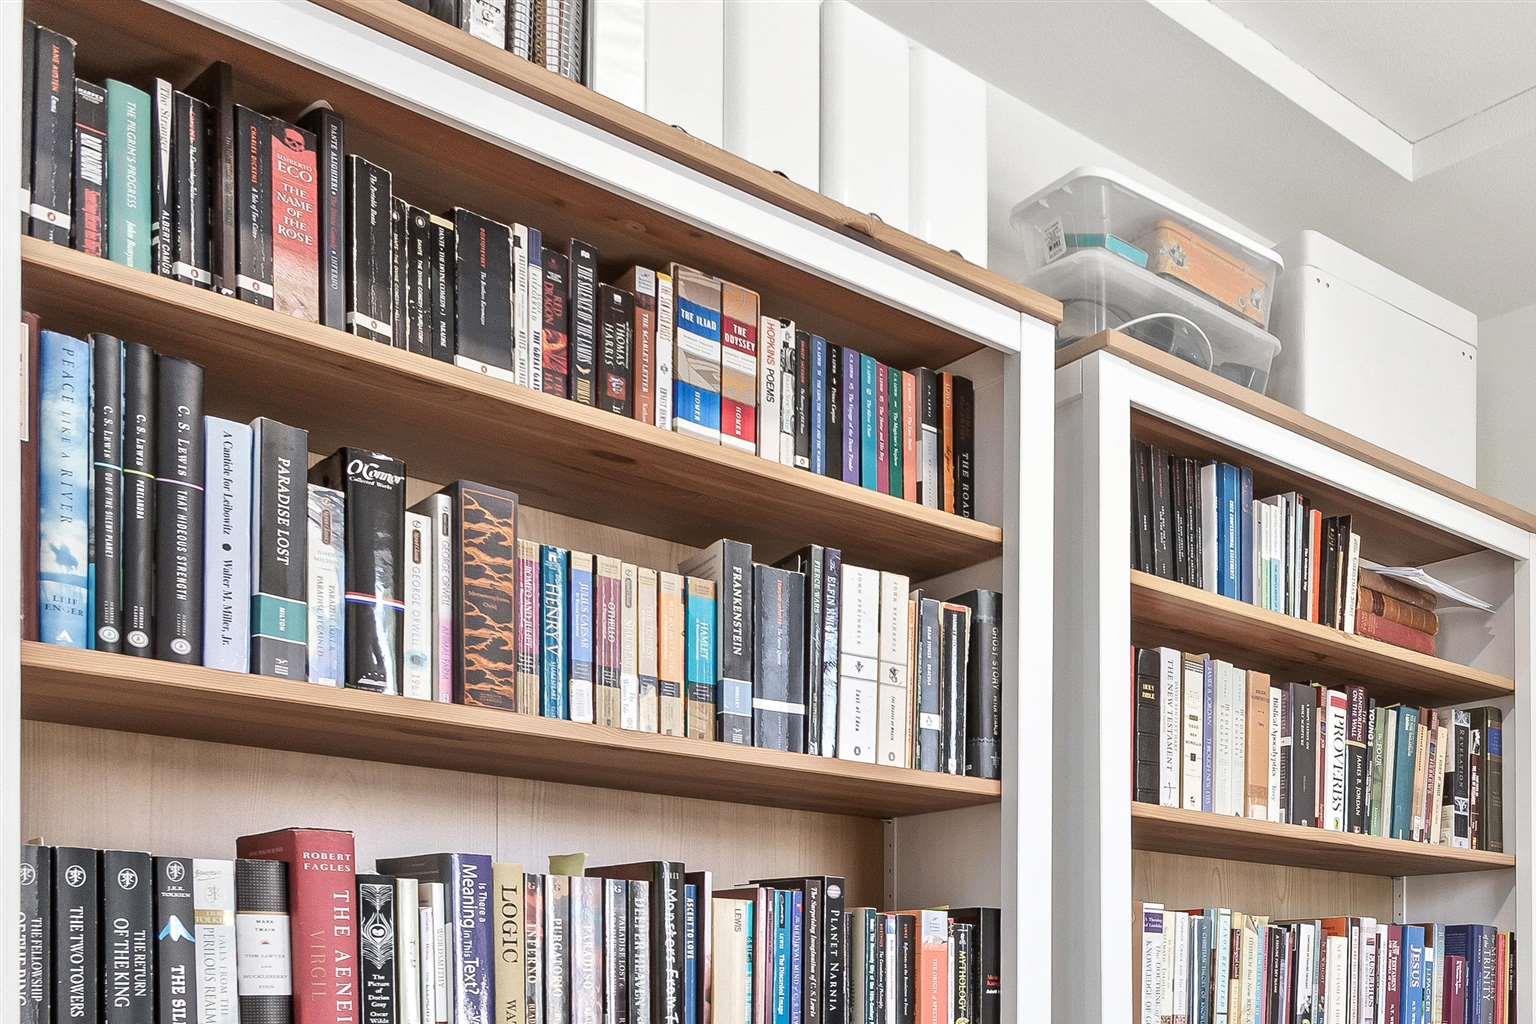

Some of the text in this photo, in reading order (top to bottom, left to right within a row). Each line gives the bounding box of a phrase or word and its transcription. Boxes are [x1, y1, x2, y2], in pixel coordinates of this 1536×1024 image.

[127, 102, 136, 208] THE PILGRIM'S PROGRESS
[330, 125, 338, 149] DANTE
[330, 151, 339, 190] ALIGHIERI
[604, 323, 614, 366] HARRIS
[615, 322, 625, 366] THOMAS
[765, 322, 777, 402] HOPKINS POEMS
[177, 405, 190, 476] C. S. LEWIS
[223, 441, 234, 476] Canticle
[176, 490, 188, 511] THAT
[223, 478, 234, 491] for
[961, 453, 970, 518] THE ROAD
[176, 514, 188, 553] HIDEOUS
[223, 493, 234, 535] Leibowitz
[276, 457, 290, 565] PARADISE LOST
[176, 556, 188, 600] STRENGTH
[221, 559, 233, 645] Walter M. Miller, Jr.
[545, 583, 561, 656] HENRY V
[732, 566, 742, 655] FRANKENSTEIN
[1166, 711, 1174, 771] TESTAMENT
[1331, 713, 1345, 812] PROVERBS
[303, 851, 351, 860] ROBERT
[304, 863, 352, 872] FAGLES
[332, 890, 349, 937] THE
[460, 864, 476, 928] Meaning
[479, 891, 487, 914] There
[501, 884, 518, 963] LOGIC
[734, 908, 742, 932] LEWIS
[70, 906, 84, 1017] THE TWO TOWERS
[113, 918, 130, 1008] OF THE KING
[133, 930, 147, 997] THE RETURN
[309, 929, 325, 1001] VIRGIL
[464, 940, 472, 958] This
[829, 909, 840, 1012] PLANET NARNIA
[1410, 944, 1422, 988] JESUS
[171, 965, 185, 995] THE
[464, 958, 479, 995] Text?
[958, 950, 966, 1011] MYTHOLOGY
